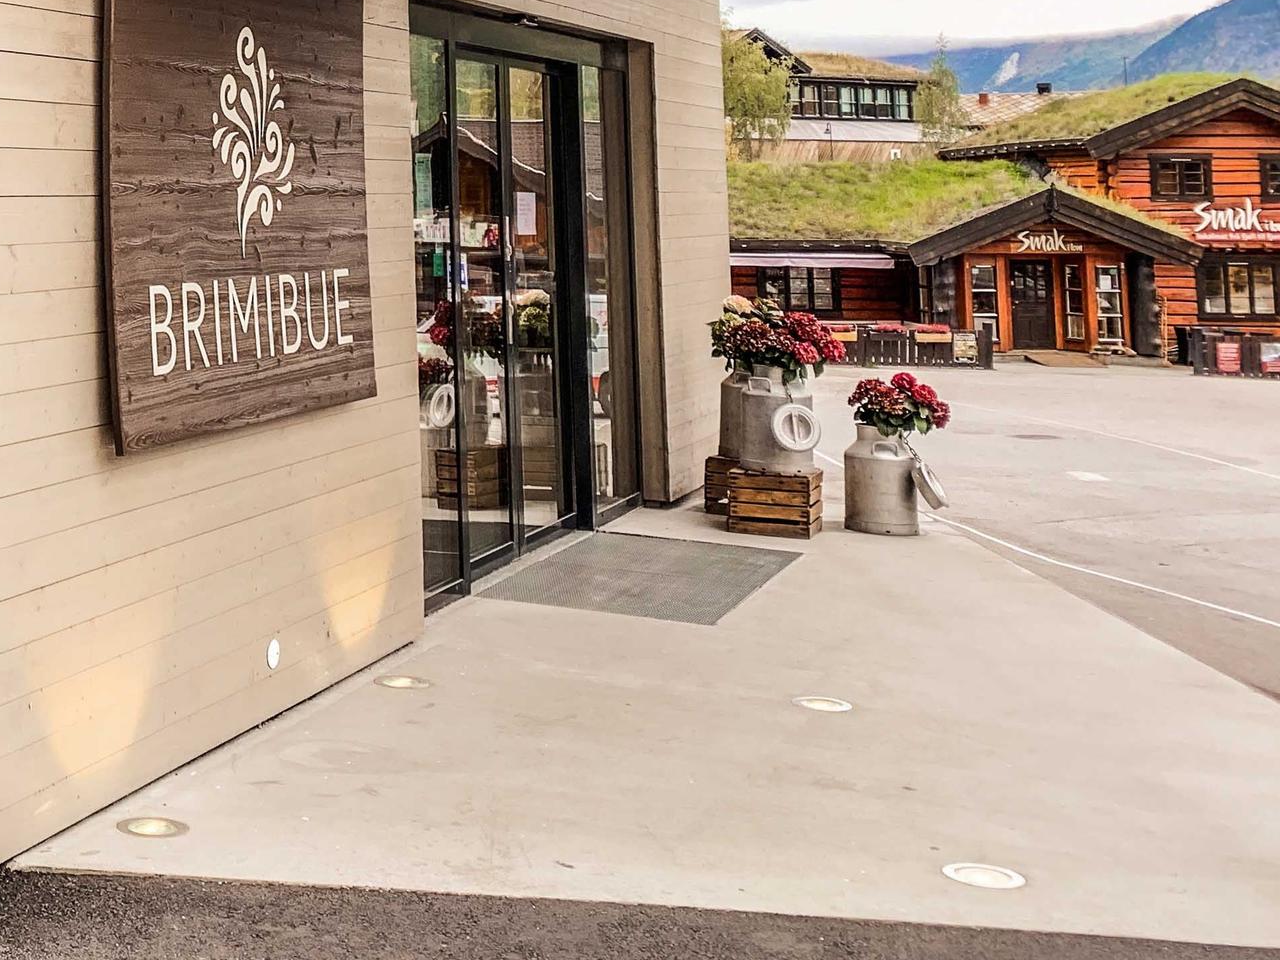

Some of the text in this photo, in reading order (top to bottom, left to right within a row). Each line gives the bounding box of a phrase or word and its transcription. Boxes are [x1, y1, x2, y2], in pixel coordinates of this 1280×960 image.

[1193, 197, 1263, 232] Smak
[1017, 227, 1067, 253] Smak
[148, 268, 354, 377] BRIMIBUE
